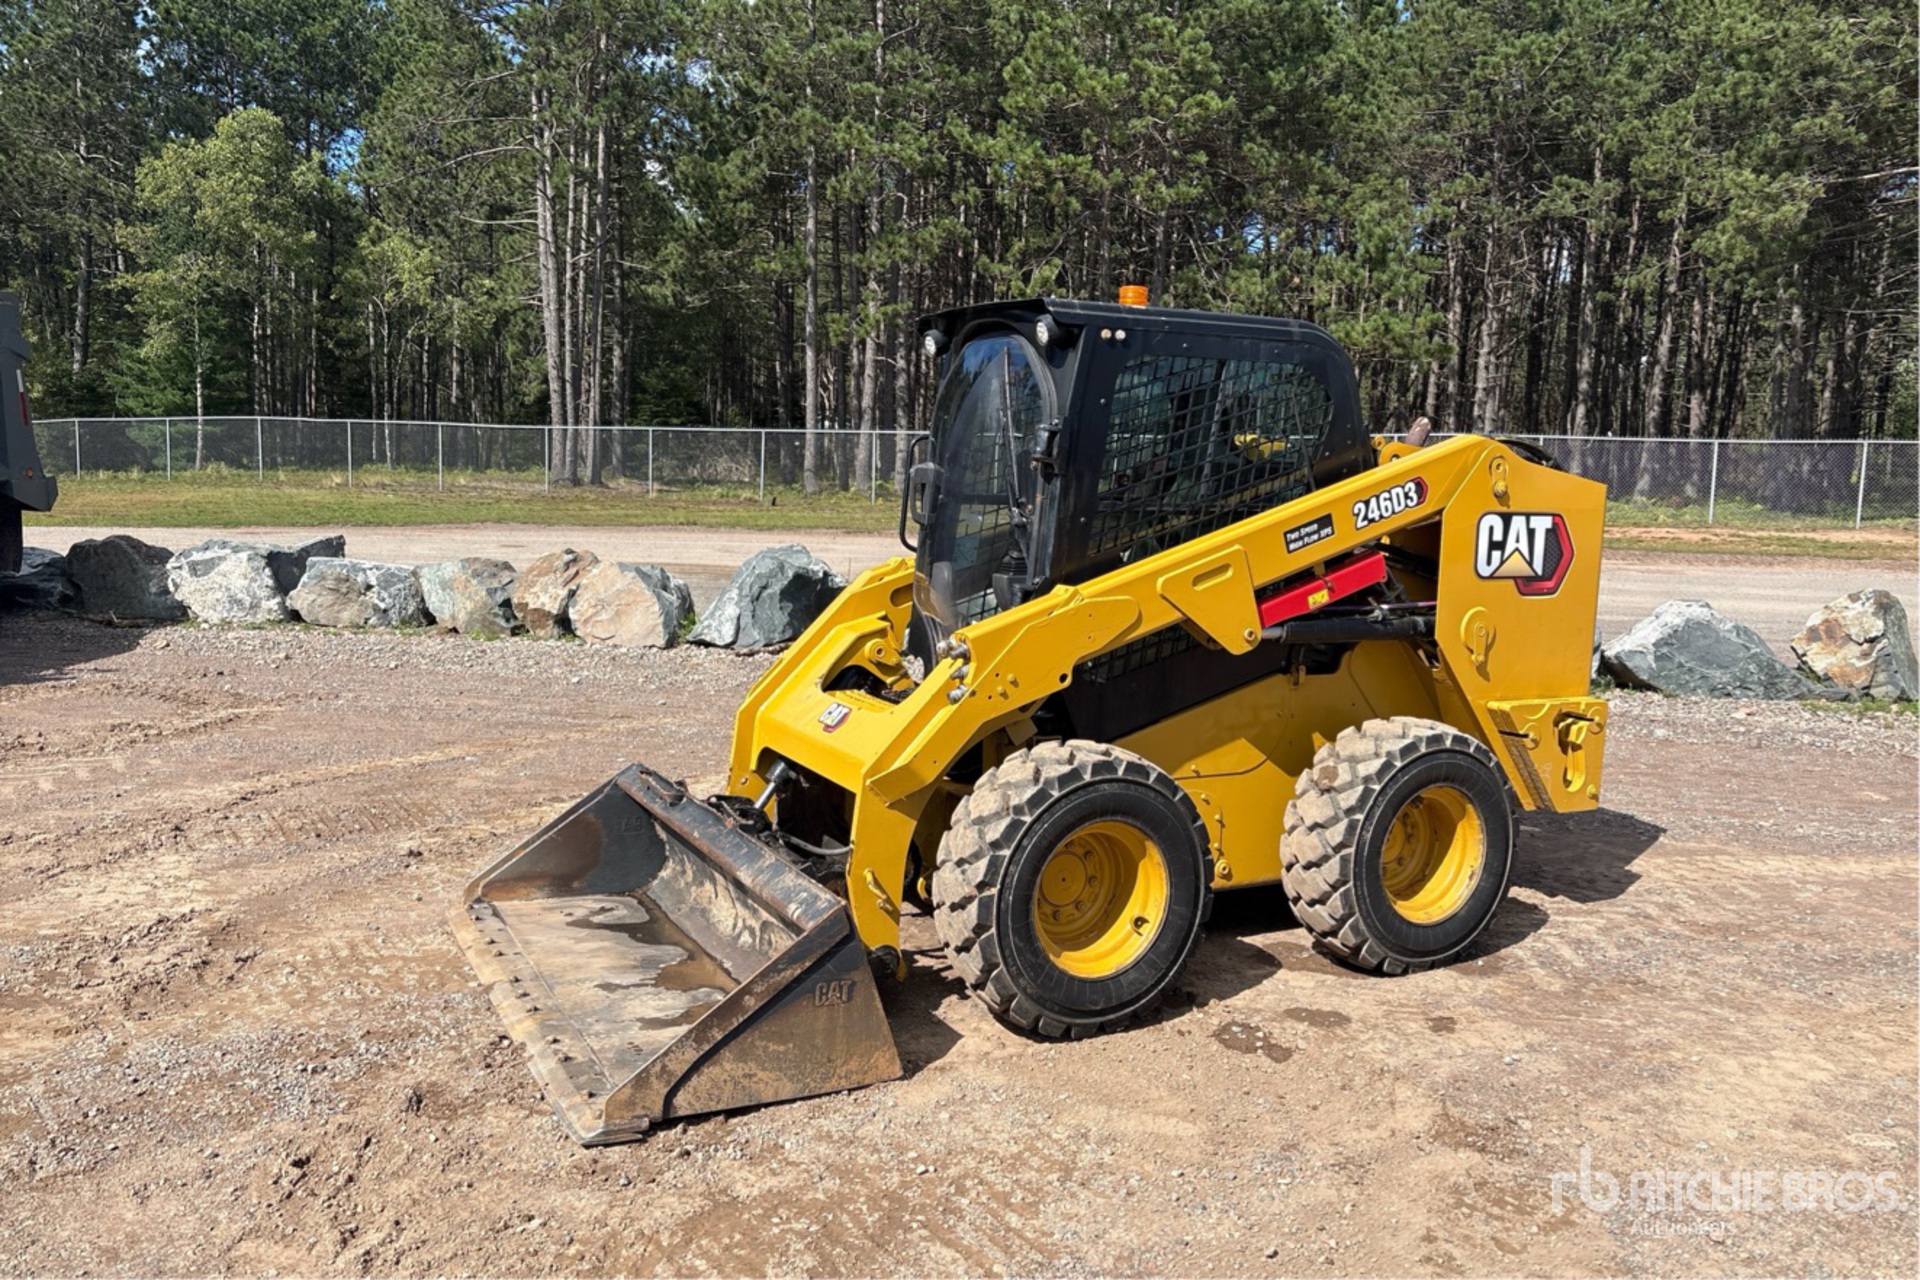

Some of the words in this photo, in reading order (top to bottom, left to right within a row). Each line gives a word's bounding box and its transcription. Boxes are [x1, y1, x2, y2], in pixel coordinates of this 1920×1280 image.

[1353, 481, 1418, 529] 246D3
[1476, 513, 1553, 577] CAT
[815, 980, 853, 1007] CAT
